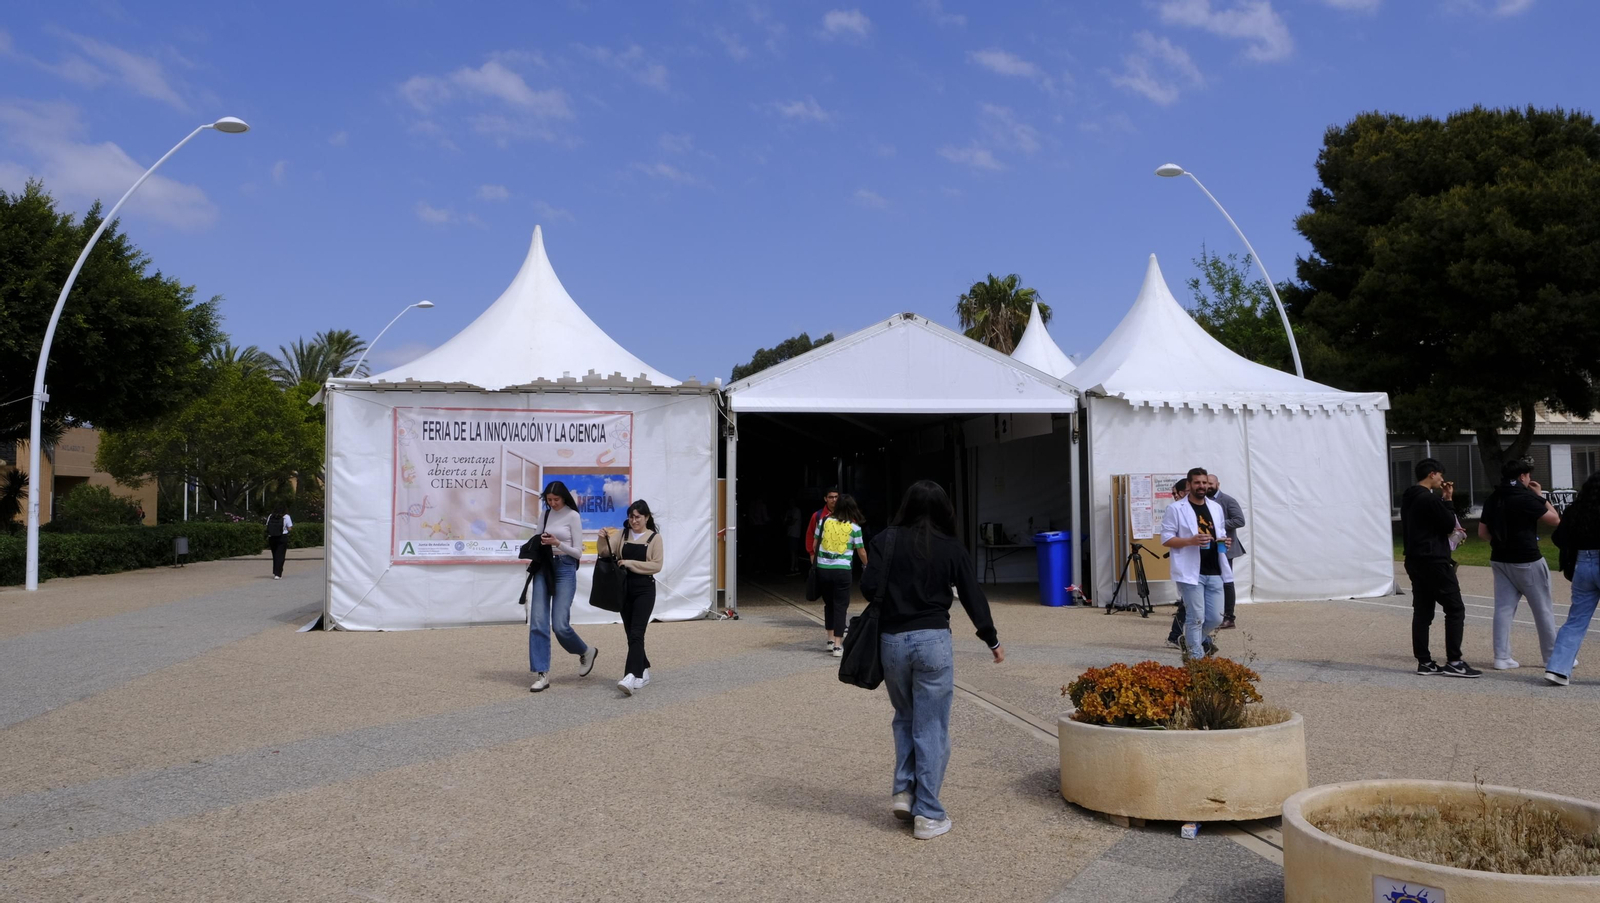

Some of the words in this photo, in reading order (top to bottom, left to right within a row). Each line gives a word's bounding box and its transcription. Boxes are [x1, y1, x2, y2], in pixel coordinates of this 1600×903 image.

[422, 420, 452, 440] FERIA
[454, 421, 466, 441] DE
[470, 422, 482, 441] LA
[484, 417, 544, 442] INNOVACIÓN
[546, 423, 552, 442] Y
[554, 423, 567, 442] LA
[569, 423, 607, 443] CIENCIA
[425, 454, 448, 464] Una
[427, 463, 467, 476] abierta
[481, 464, 492, 476] la
[430, 478, 488, 488] CIENCIA
[578, 491, 615, 513] MERÍA
